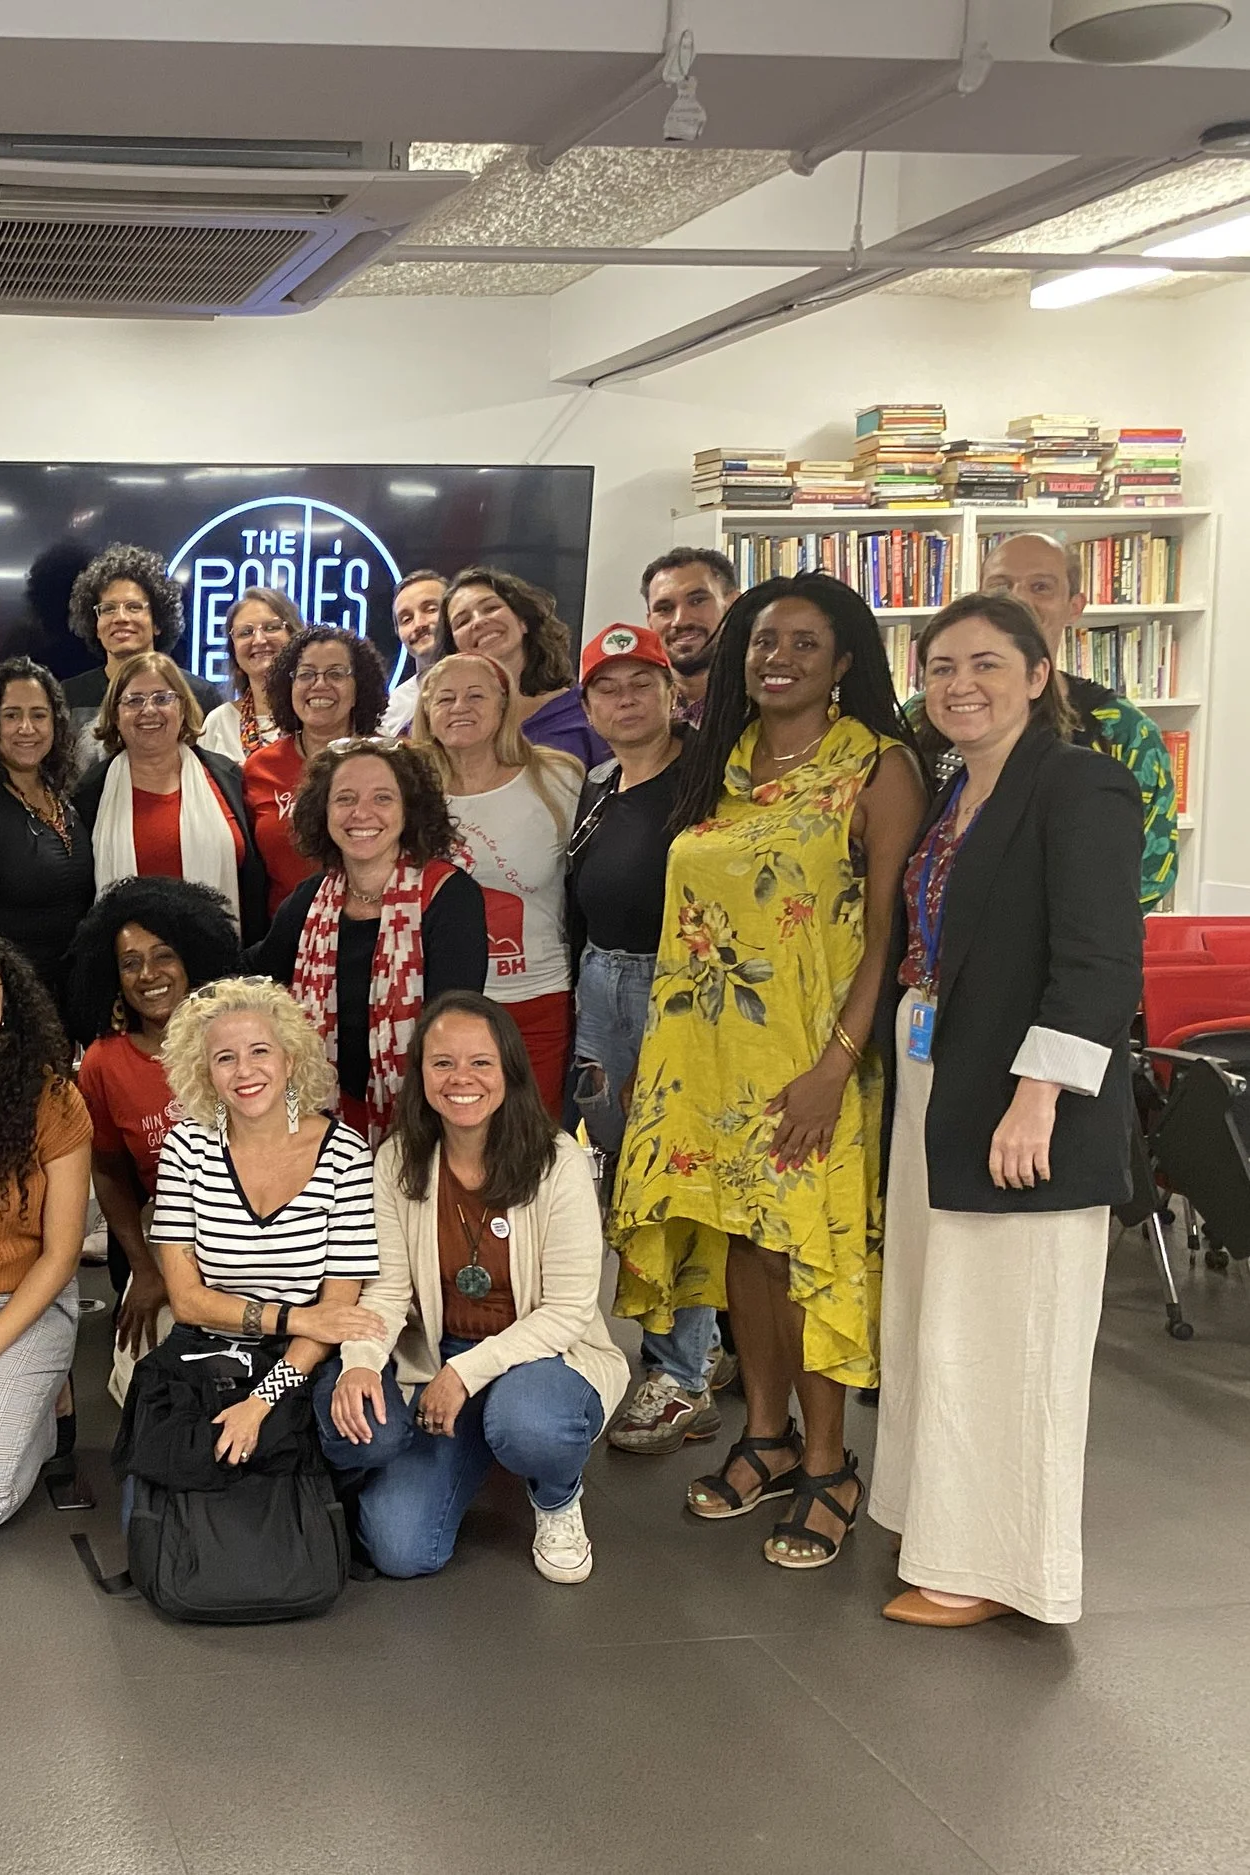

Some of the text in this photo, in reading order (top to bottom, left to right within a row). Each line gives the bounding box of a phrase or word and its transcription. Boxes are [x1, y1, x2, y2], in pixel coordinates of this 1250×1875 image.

[241, 529, 297, 555] THE
[1174, 743, 1187, 799] Emergency
[496, 957, 526, 976] BH
[141, 1112, 163, 1131] NIN
